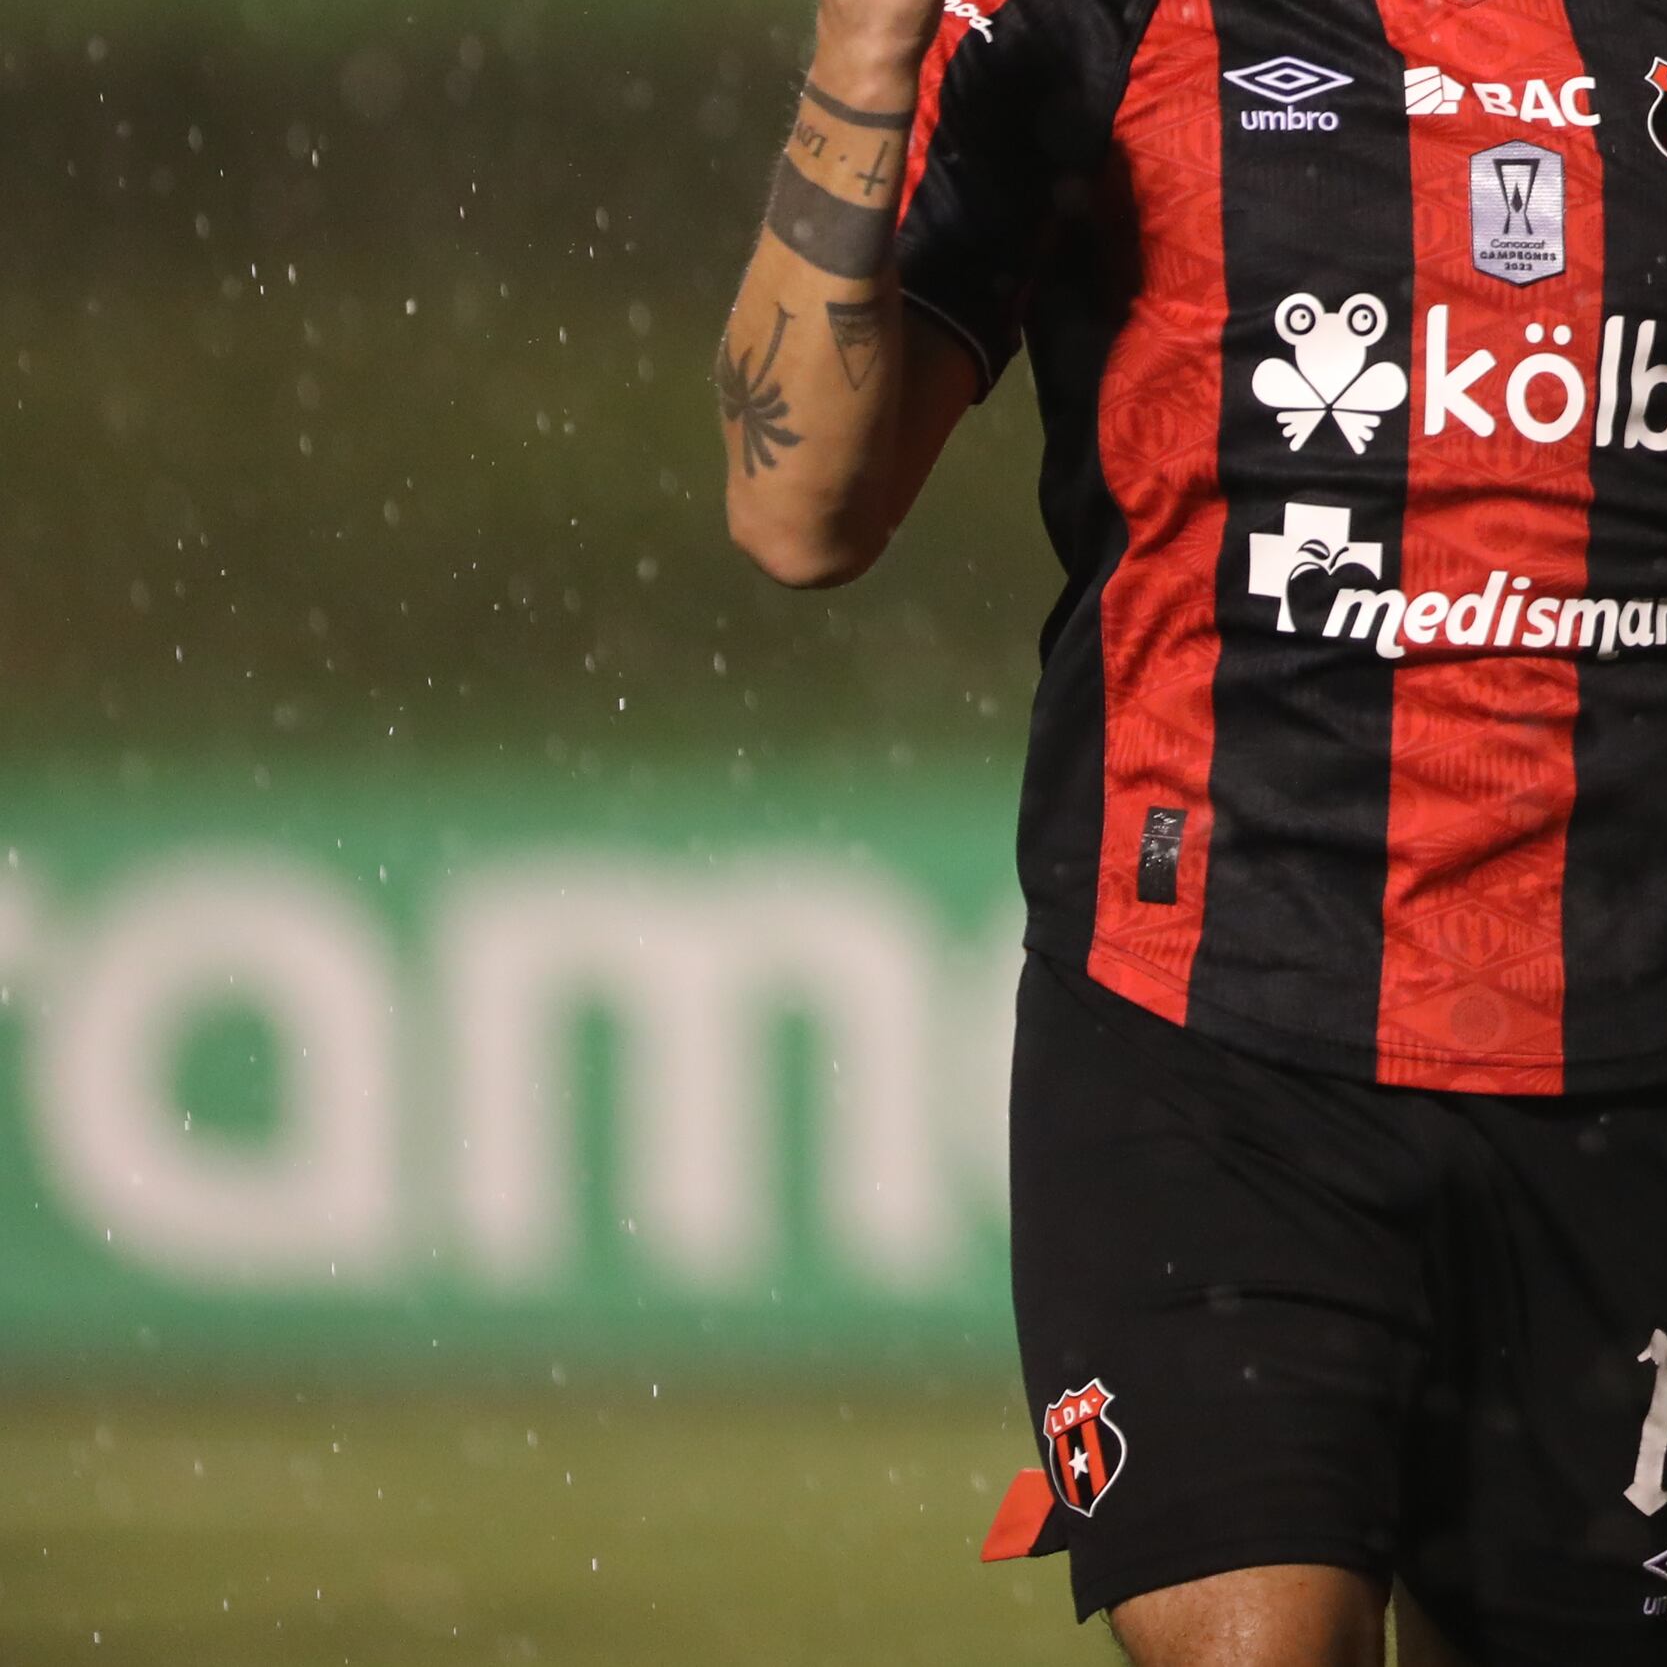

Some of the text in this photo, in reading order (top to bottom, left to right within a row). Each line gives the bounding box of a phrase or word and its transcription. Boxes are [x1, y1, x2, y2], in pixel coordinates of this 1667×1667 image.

[1472, 76, 1601, 127] BAC
[1240, 106, 1339, 132] umbro
[1479, 251, 1558, 262] CAMPEONES
[1489, 238, 1547, 250] Concacaf
[0, 844, 1025, 1284] am
[1050, 1399, 1093, 1434] LDA
